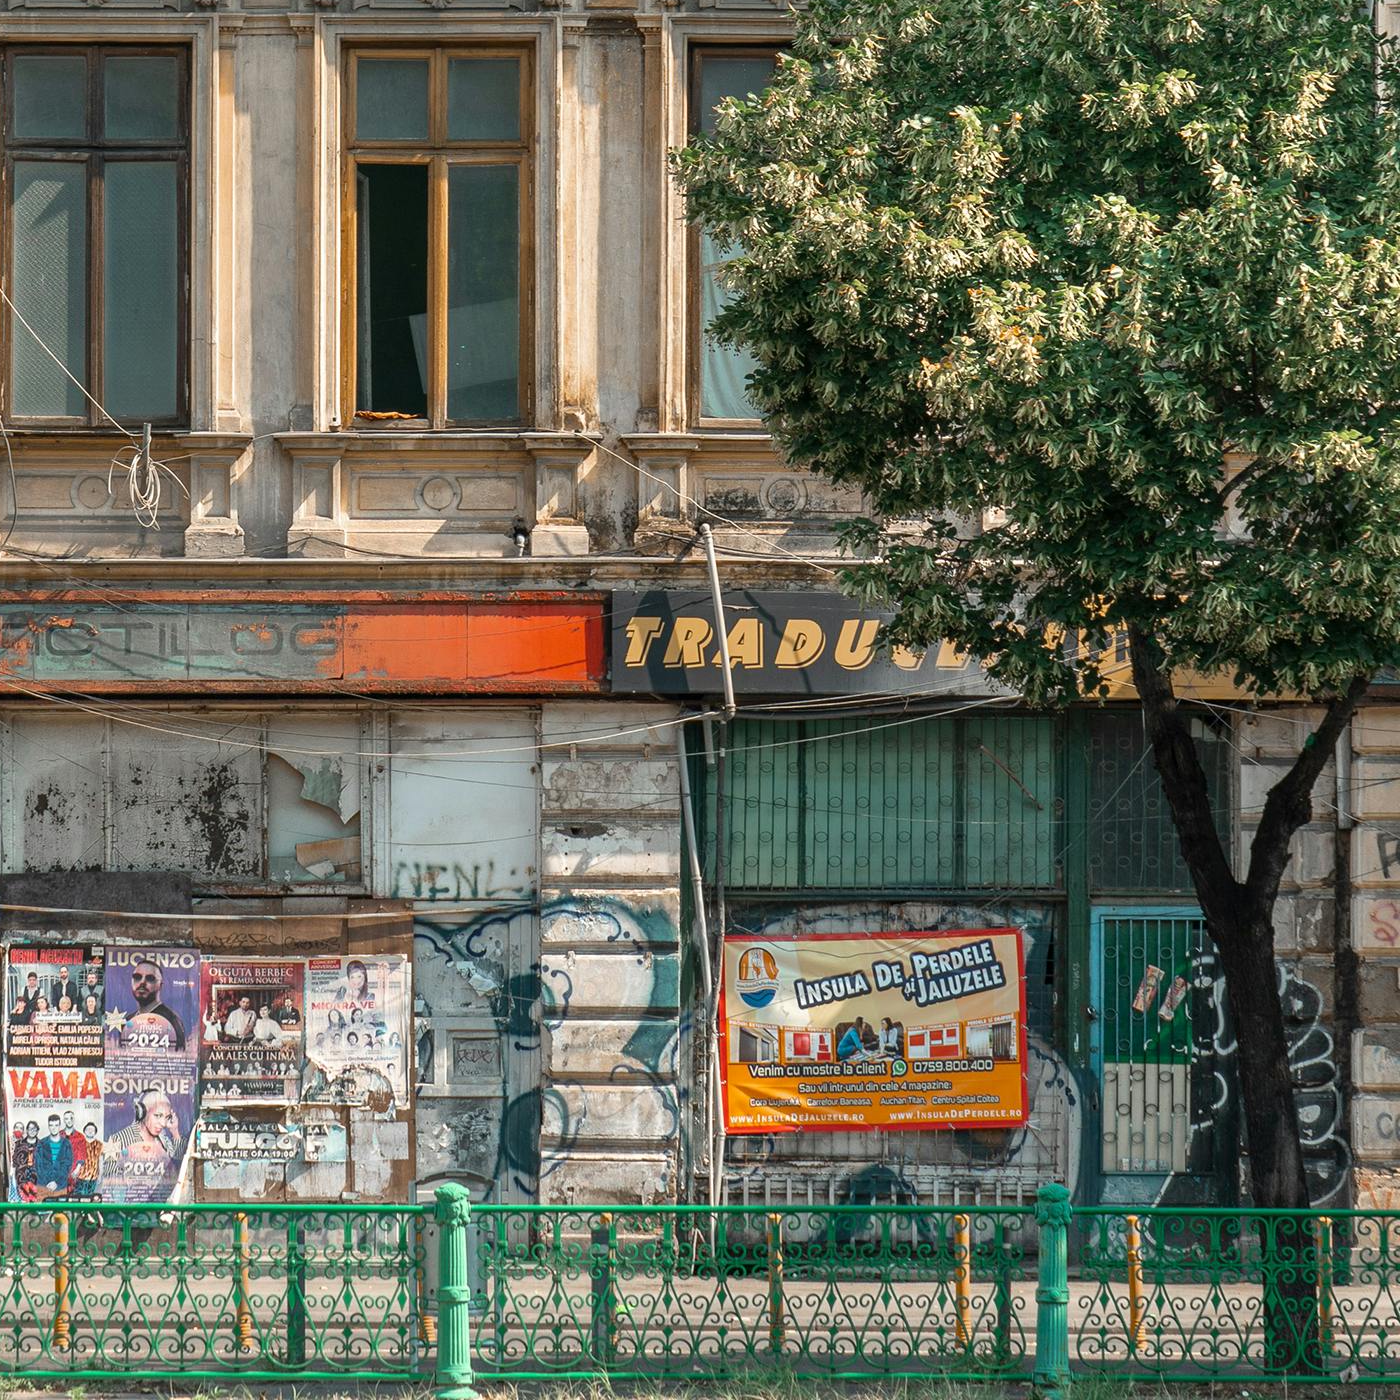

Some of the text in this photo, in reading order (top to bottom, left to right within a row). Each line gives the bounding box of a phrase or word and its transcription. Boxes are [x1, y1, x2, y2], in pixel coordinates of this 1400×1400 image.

[108, 951, 196, 968] LUCENZO
[255, 967, 294, 977] BERBEC
[795, 973, 869, 1007] INSULA
[912, 942, 993, 978] PERDELE
[918, 965, 1003, 1004] JALUZELE
[10, 1024, 34, 1034] CARMEN
[58, 1025, 75, 1034] EMILIA
[77, 1025, 103, 1034] POPESCU
[12, 1036, 33, 1044] MIRELA
[60, 1036, 83, 1044] NATALIA
[128, 1033, 170, 1048] 2024
[10, 1046, 31, 1055] ADRIAN
[53, 1047, 67, 1055] VLAD
[209, 1051, 224, 1060] AM
[228, 1051, 248, 1060] ALES
[249, 1051, 264, 1060] CU
[35, 1058, 54, 1066] TUDOR
[913, 1060, 993, 1072] 0759.800.400
[750, 1063, 885, 1077] Venim cu mostre la client
[8, 1069, 102, 1099] VAMA
[103, 1079, 189, 1095] SONIQUE
[799, 1084, 816, 1093] Sau
[866, 1082, 878, 1091] din
[880, 1081, 898, 1090] cele
[901, 1081, 907, 1090] 4
[909, 1080, 951, 1092] magazine:
[234, 1124, 279, 1132] PALATU
[200, 1132, 300, 1150] FUEGO
[214, 1150, 249, 1158] MARTIE
[251, 1150, 270, 1158] ORA
[124, 1161, 165, 1176] 2024
